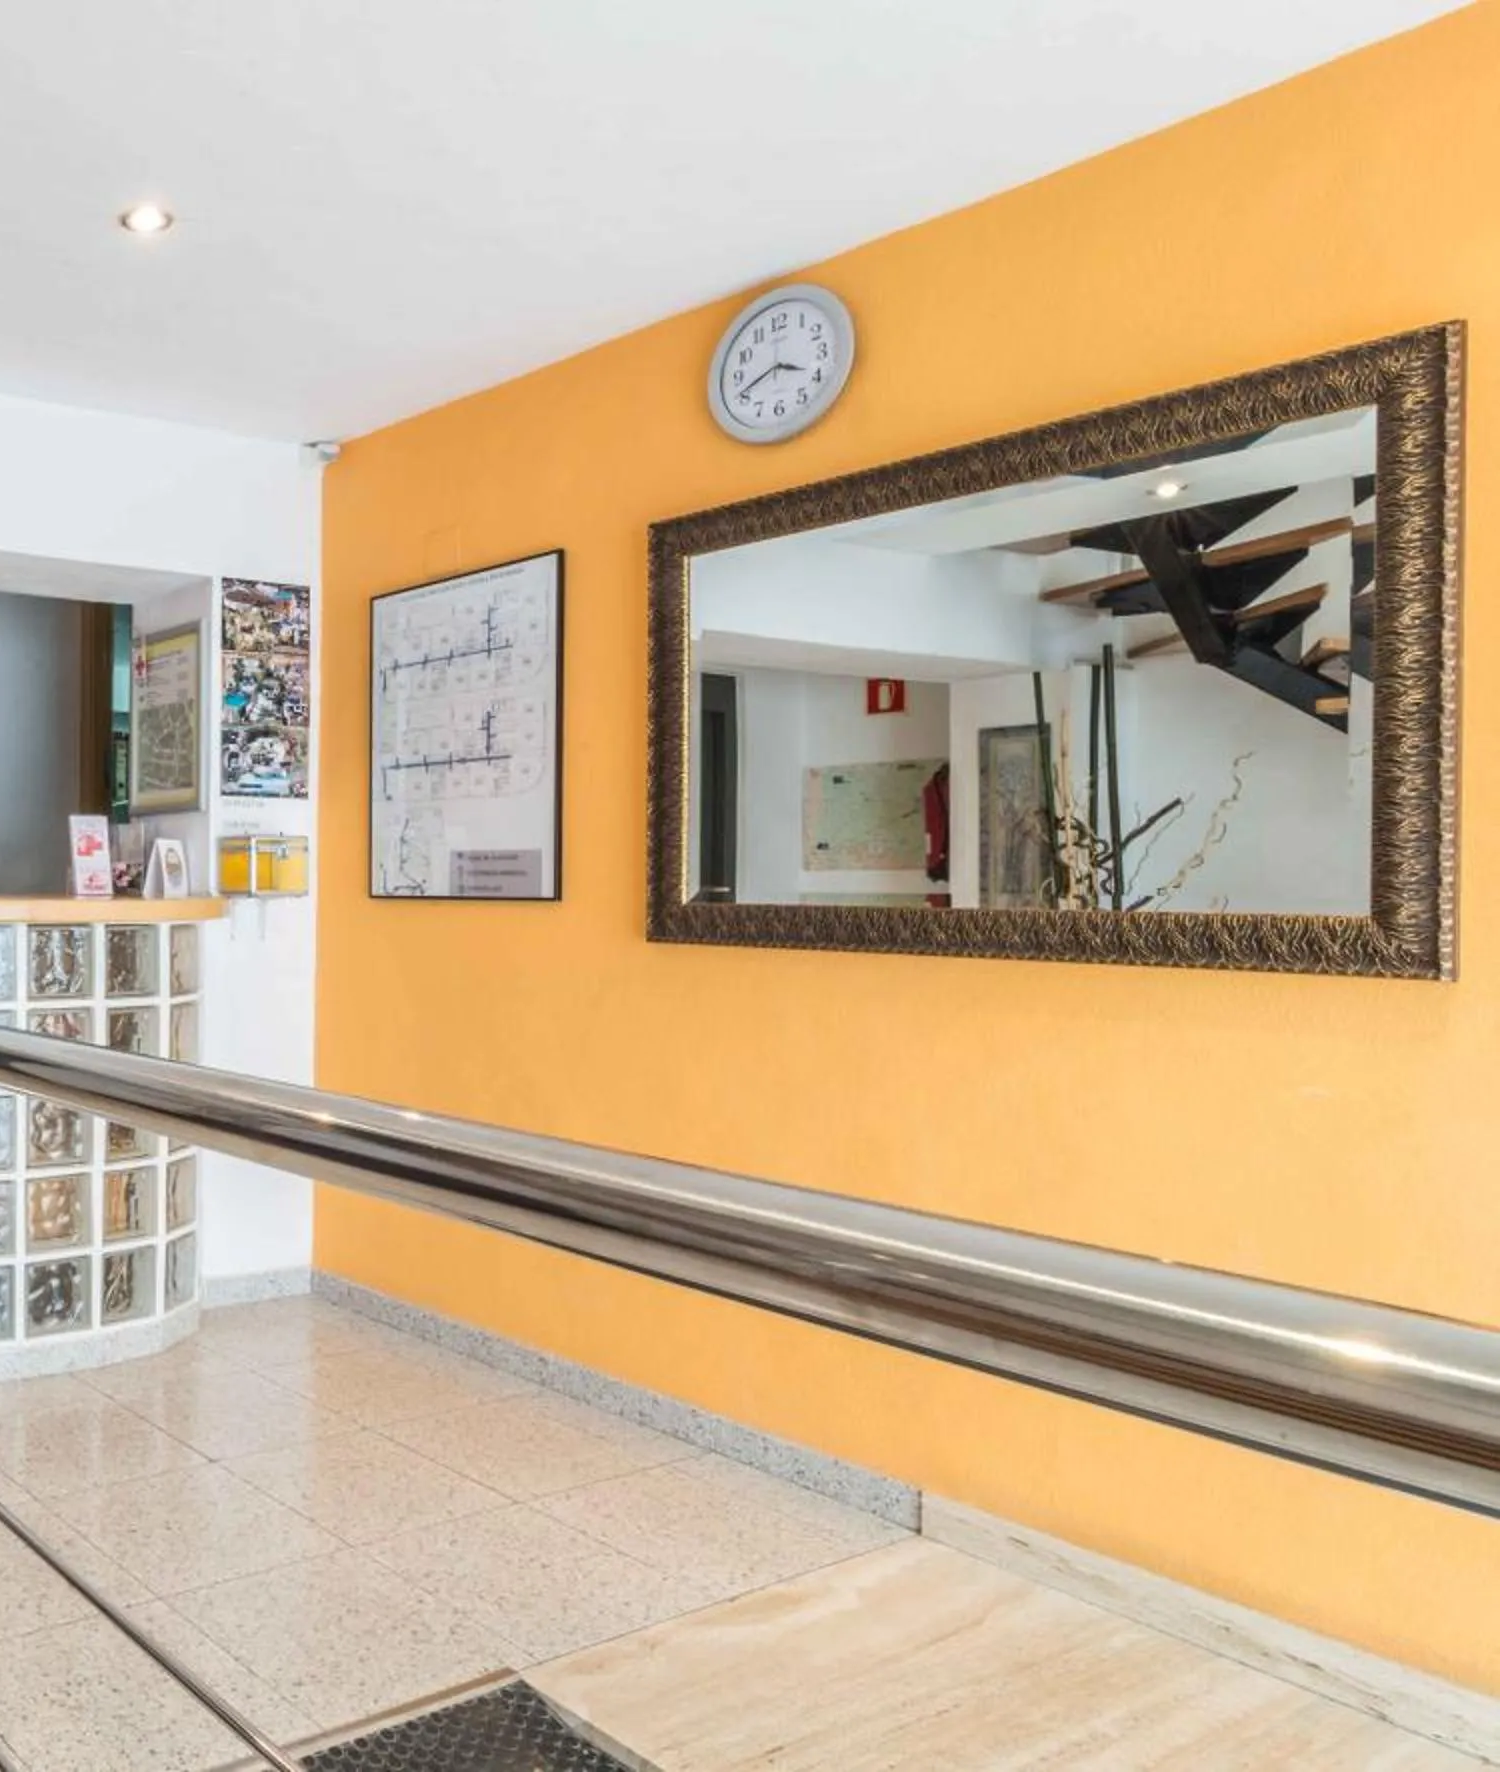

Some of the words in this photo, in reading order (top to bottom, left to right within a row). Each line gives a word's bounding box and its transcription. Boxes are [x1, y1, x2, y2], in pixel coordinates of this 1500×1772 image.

[771, 312, 788, 333] 12
[799, 312, 805, 329] 1
[753, 327, 765, 344] 11
[810, 323, 822, 341] 2
[739, 348, 753, 364] 10
[816, 343, 828, 361] 3
[733, 370, 744, 386] 9
[812, 368, 822, 383] 4
[739, 391, 751, 405] 8
[796, 387, 807, 405] 5
[754, 401, 764, 418] 7
[773, 400, 785, 416] 6
